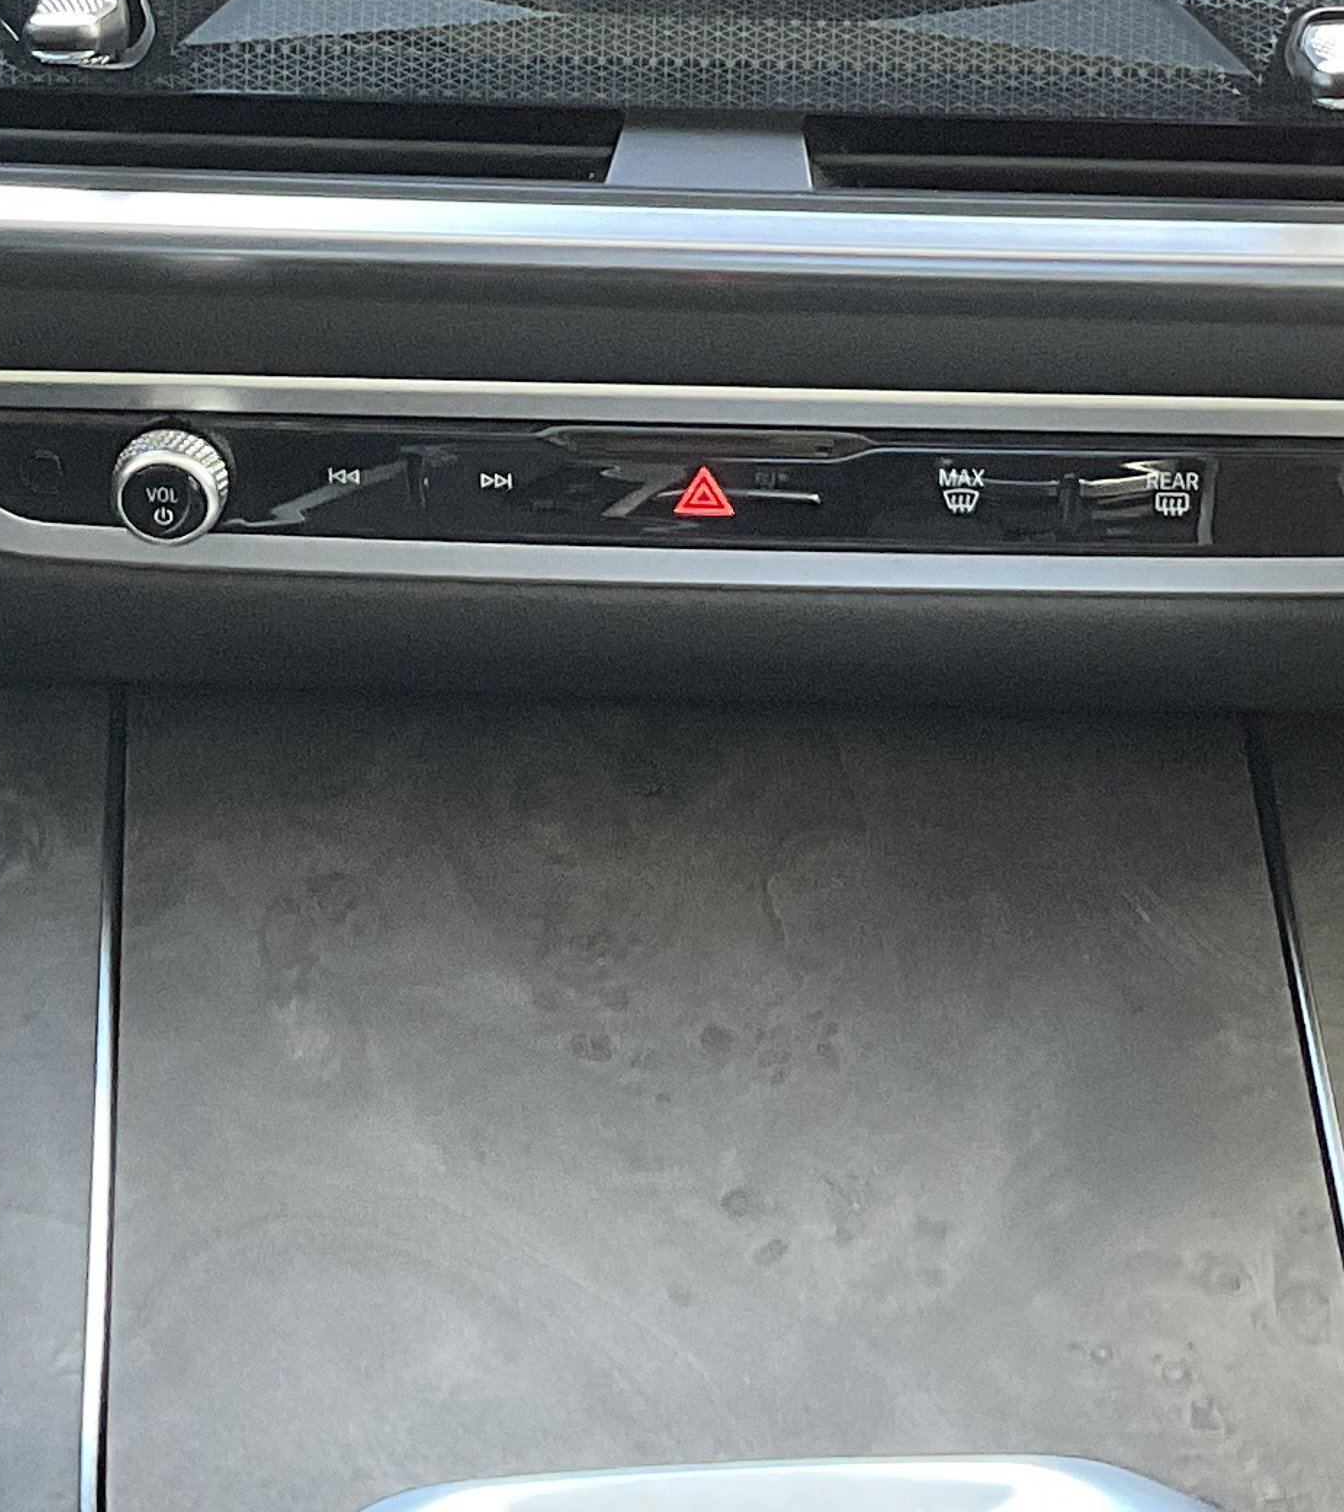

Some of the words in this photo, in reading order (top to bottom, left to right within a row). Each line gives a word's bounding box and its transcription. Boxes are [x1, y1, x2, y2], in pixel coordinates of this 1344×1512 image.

[938, 468, 985, 487] MAX
[1146, 472, 1199, 490] REAR
[145, 486, 178, 504] VOL
